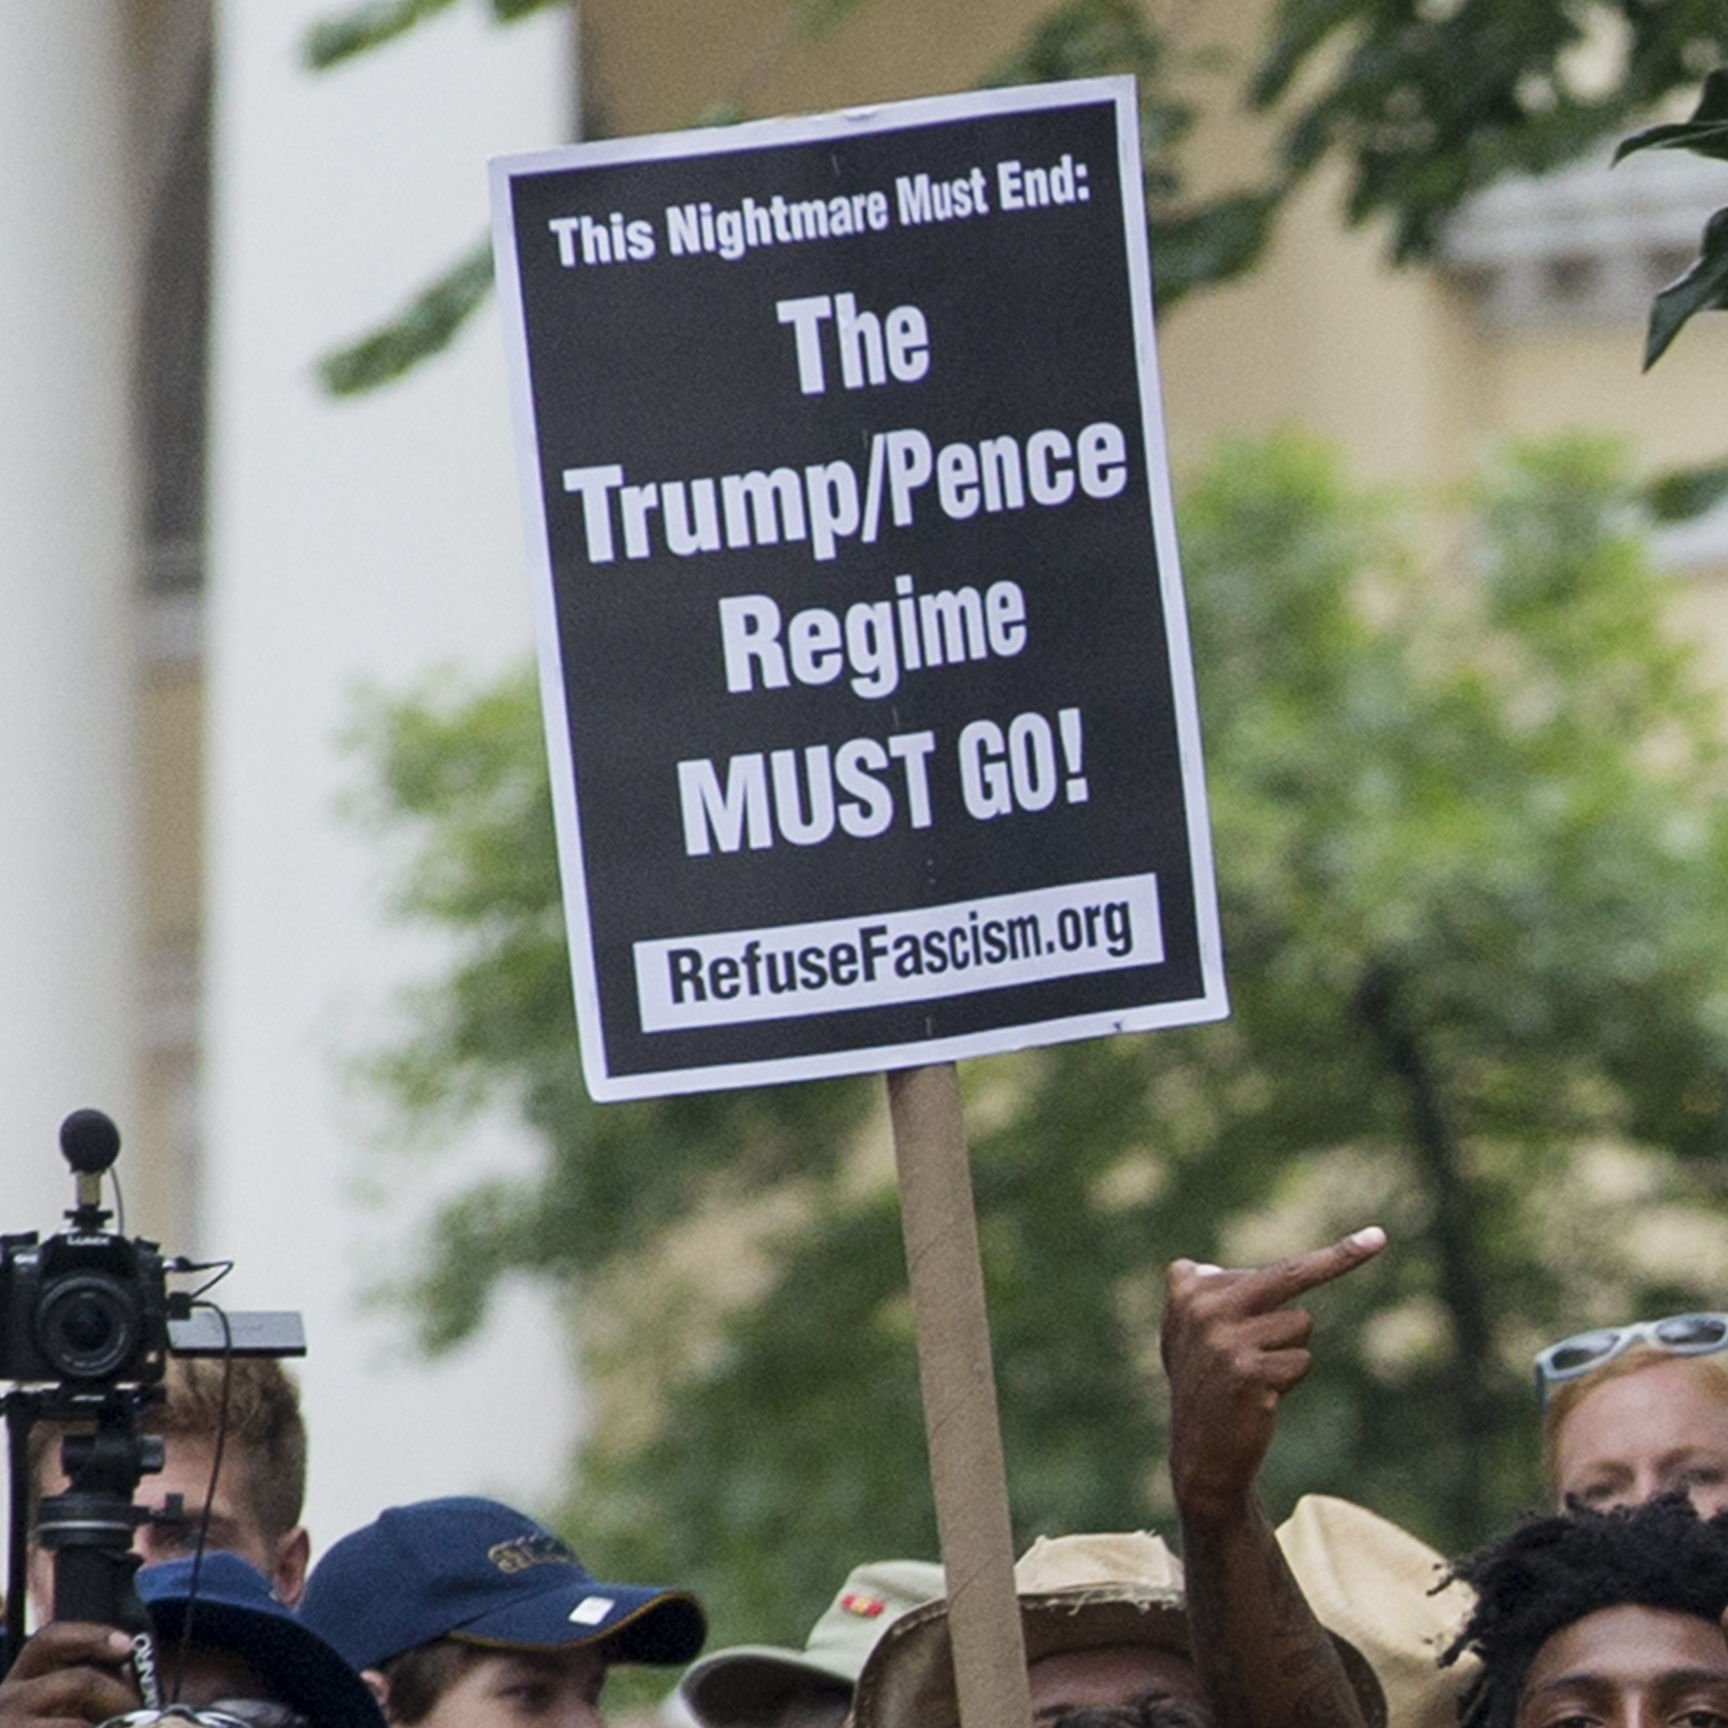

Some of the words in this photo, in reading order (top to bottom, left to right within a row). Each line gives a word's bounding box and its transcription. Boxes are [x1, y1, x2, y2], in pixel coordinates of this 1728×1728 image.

[549, 215, 656, 267] This
[666, 187, 887, 261] Nightmare
[895, 170, 989, 220] Must
[997, 154, 1091, 204] End:
[776, 292, 930, 395] The
[563, 421, 1129, 563] Trump/Pence
[718, 575, 1027, 700] Regime
[676, 731, 935, 857] MUST
[957, 708, 1090, 821] GO!
[666, 895, 1134, 1005] RefuseFascism.org
